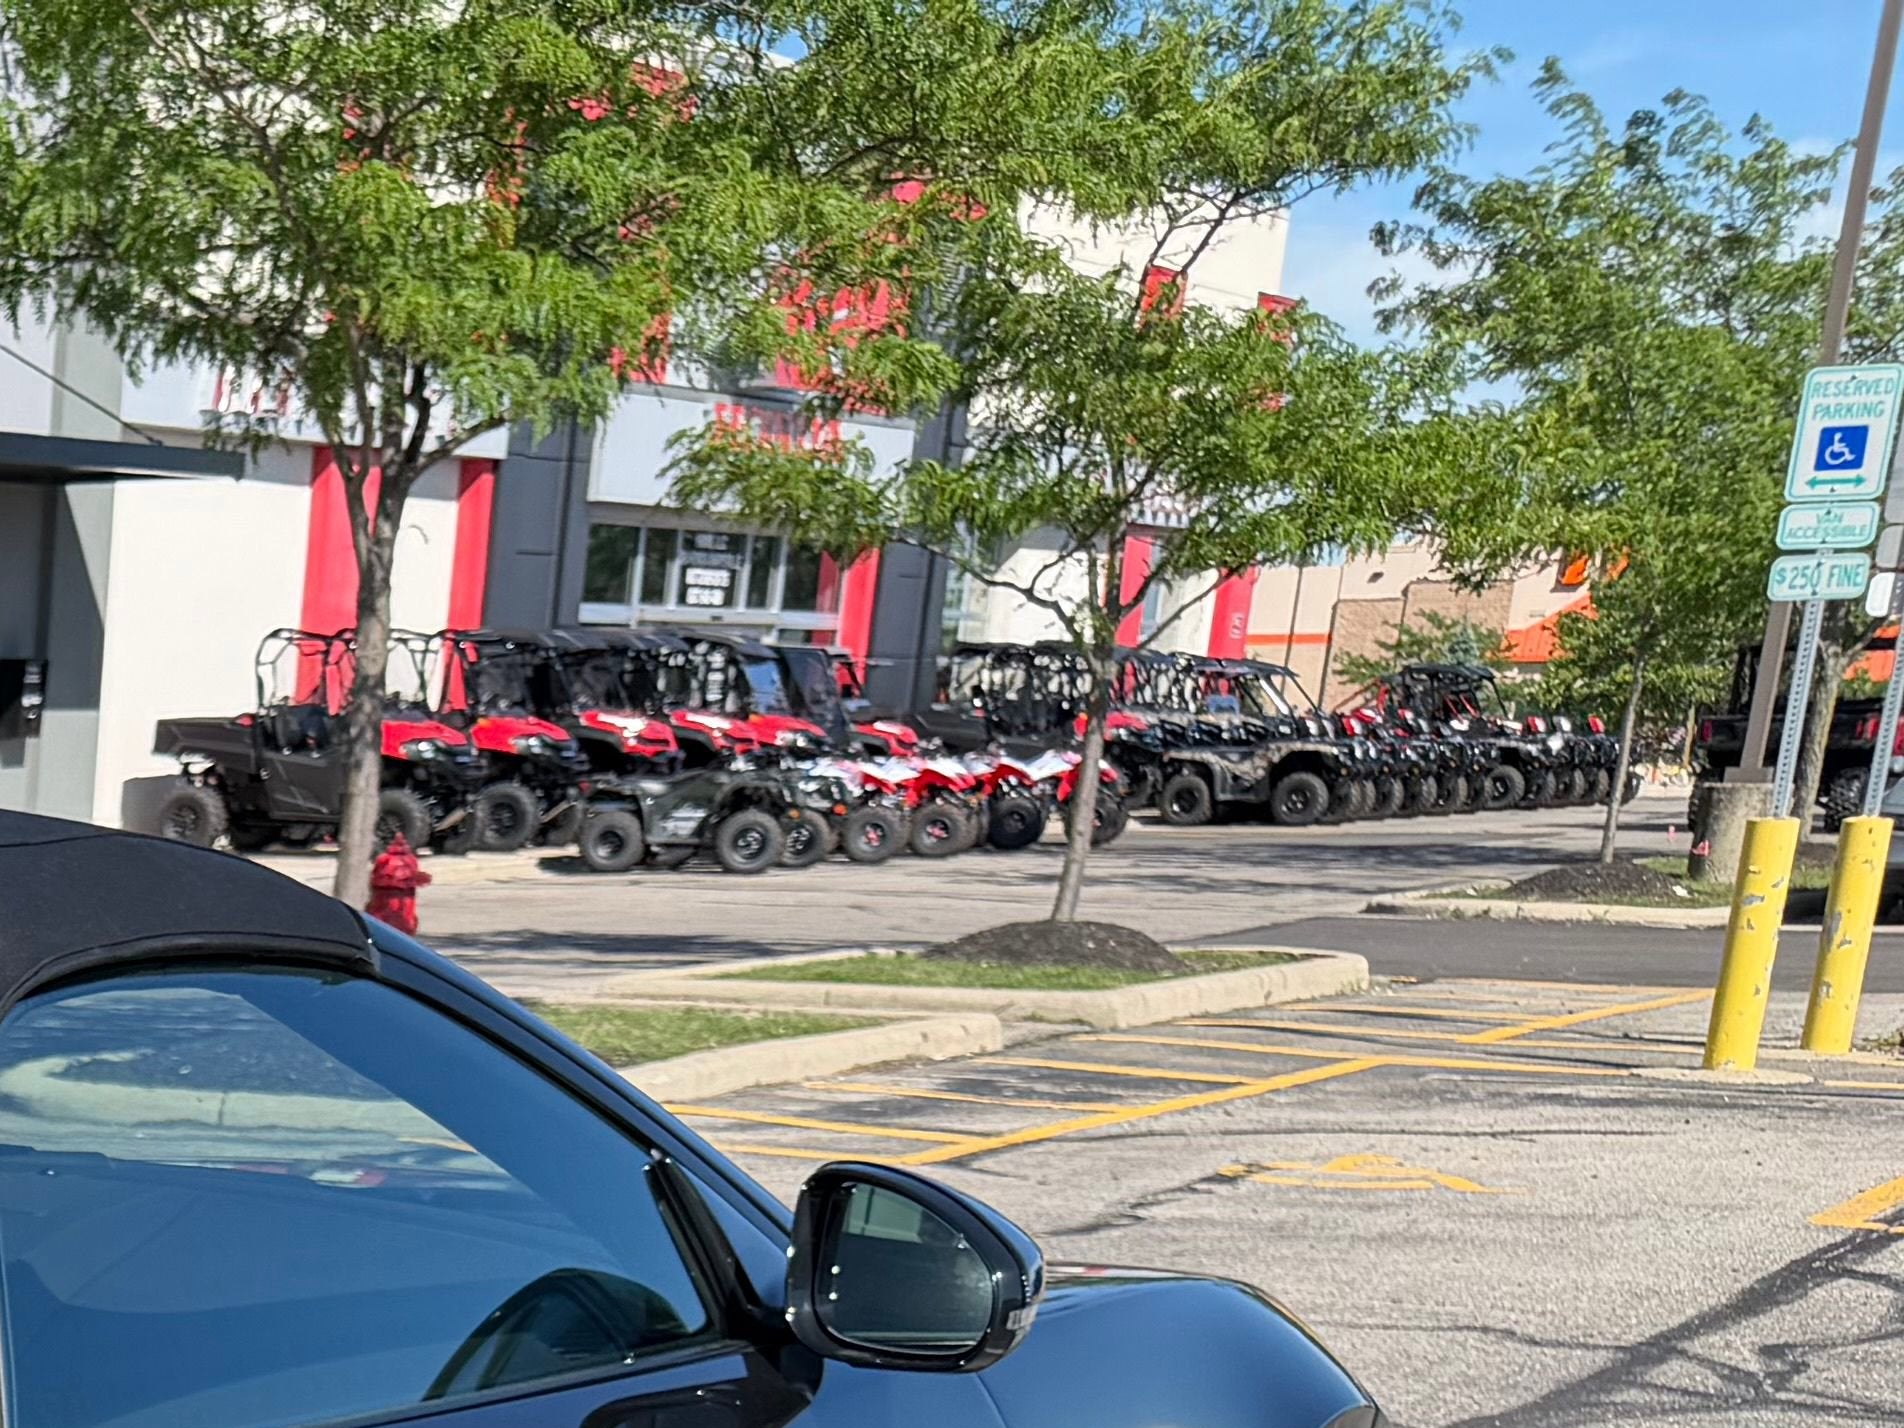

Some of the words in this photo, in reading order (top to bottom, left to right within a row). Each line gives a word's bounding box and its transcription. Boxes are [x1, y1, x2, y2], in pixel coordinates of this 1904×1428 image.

[1810, 378, 1897, 399] RESERVED
[1812, 400, 1885, 421] PARKING
[1816, 511, 1844, 524] VAN
[1787, 524, 1868, 539] ACCESSIBLE
[1826, 563, 1865, 588] FINE
